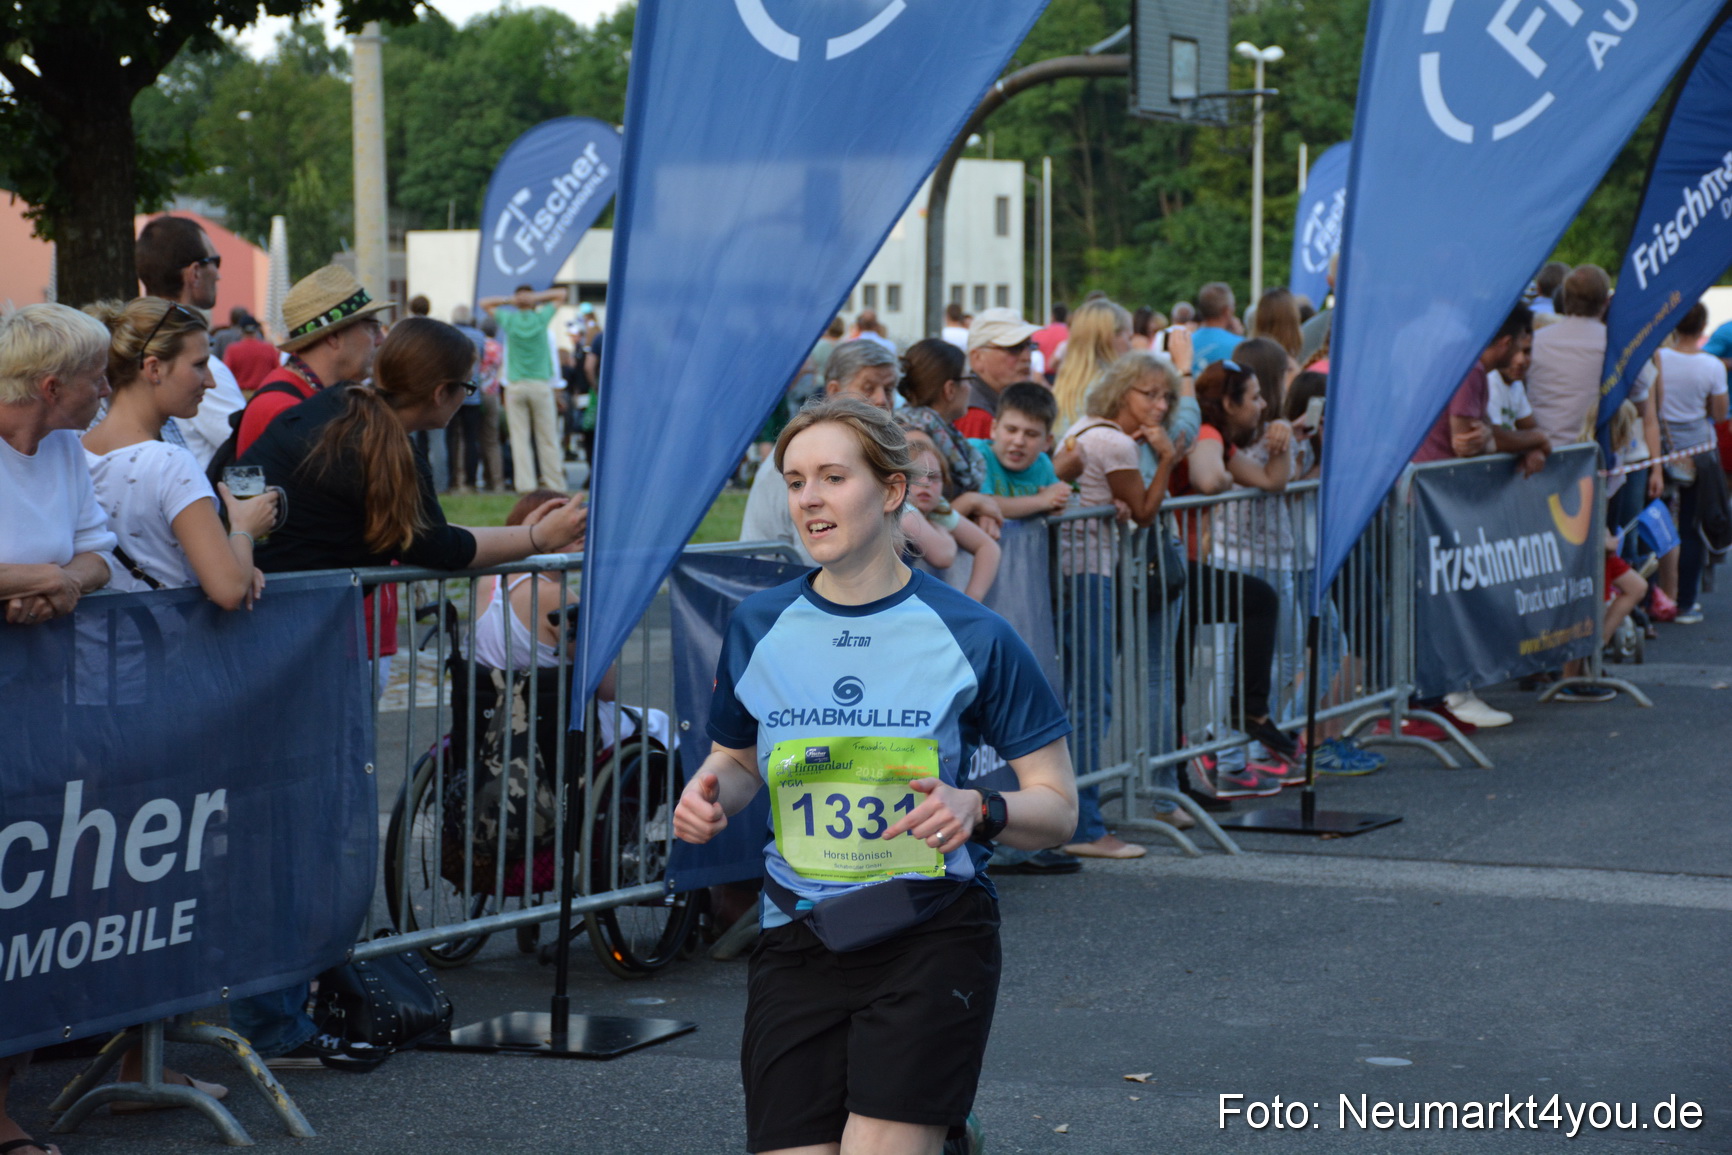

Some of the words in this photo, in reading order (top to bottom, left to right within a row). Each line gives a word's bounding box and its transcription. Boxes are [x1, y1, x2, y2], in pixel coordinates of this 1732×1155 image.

[512, 141, 600, 257] Fischer
[1428, 526, 1563, 596] Frischmann
[1514, 583, 1546, 616] Druck
[1544, 577, 1567, 609] und
[766, 707, 932, 728] SCHABMÜLLER
[793, 759, 854, 774] firmenlauf
[855, 766, 884, 778] 2016
[792, 792, 915, 840] 1331
[0, 779, 227, 910] cher
[823, 850, 849, 860] Horst
[851, 850, 893, 862] Bönisch
[0, 898, 197, 982] MOBILE
